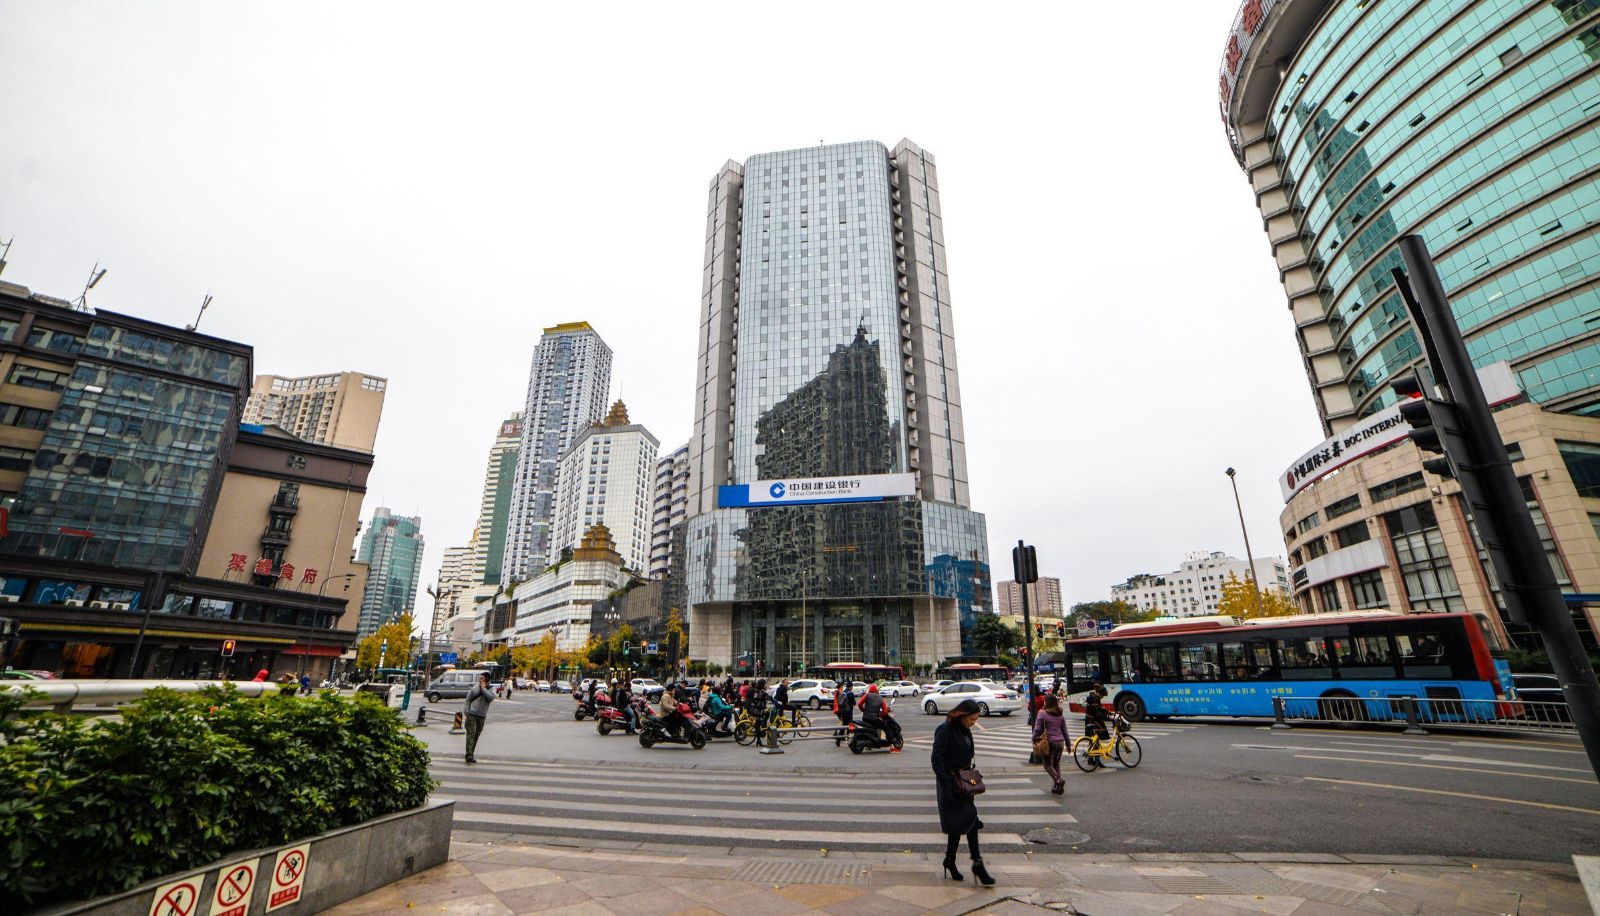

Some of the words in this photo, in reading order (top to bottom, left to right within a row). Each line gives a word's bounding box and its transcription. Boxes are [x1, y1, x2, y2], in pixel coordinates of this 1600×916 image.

[1344, 433, 1362, 448] BOC
[789, 479, 861, 491] 中国建设银行
[789, 489, 805, 497] China
[805, 488, 838, 496] Construction
